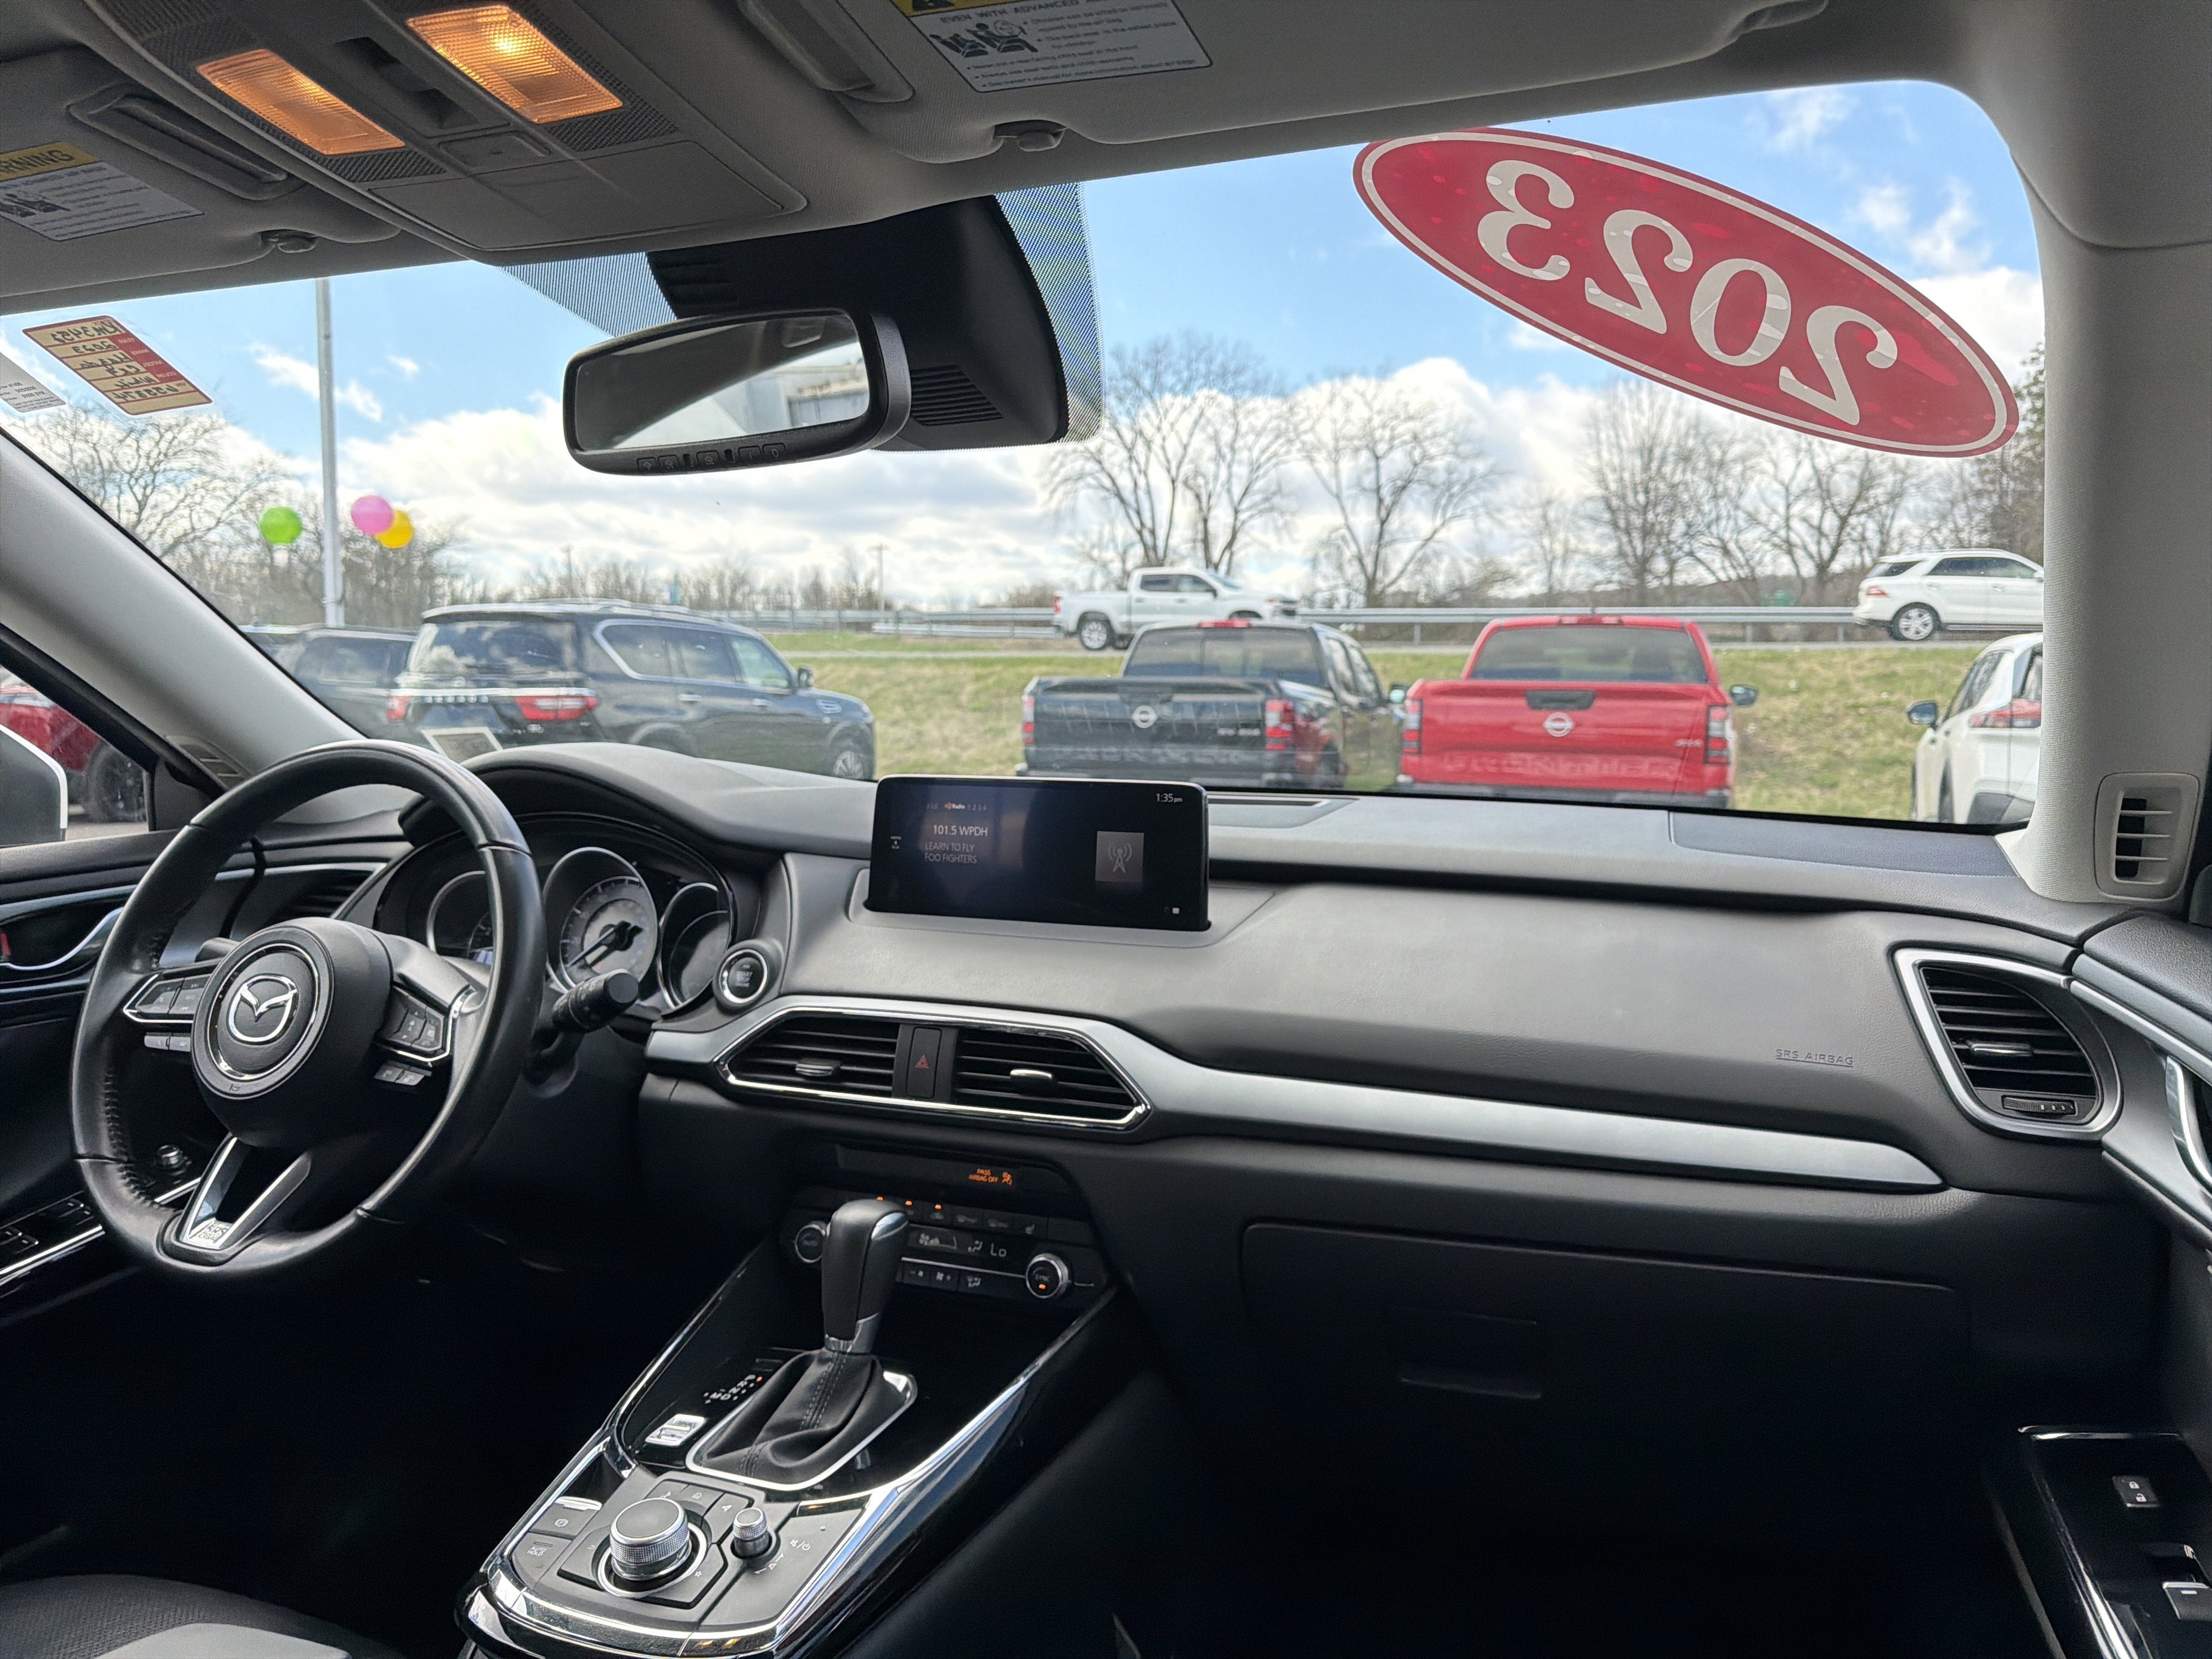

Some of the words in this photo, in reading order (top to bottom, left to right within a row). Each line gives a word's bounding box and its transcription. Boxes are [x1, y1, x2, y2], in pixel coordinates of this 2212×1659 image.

[933, 825, 957, 836] 101.5
[960, 826, 988, 837] WPDH
[925, 842, 949, 851] LEARN
[951, 843, 961, 851] TO
[962, 843, 976, 853] FLY
[924, 853, 941, 862] FOO
[942, 854, 978, 864] FIGHTERS
[1775, 1049, 1799, 1059] SRS
[1804, 1052, 1854, 1065] AIRBAG
[990, 1243, 1007, 1257] Lo
